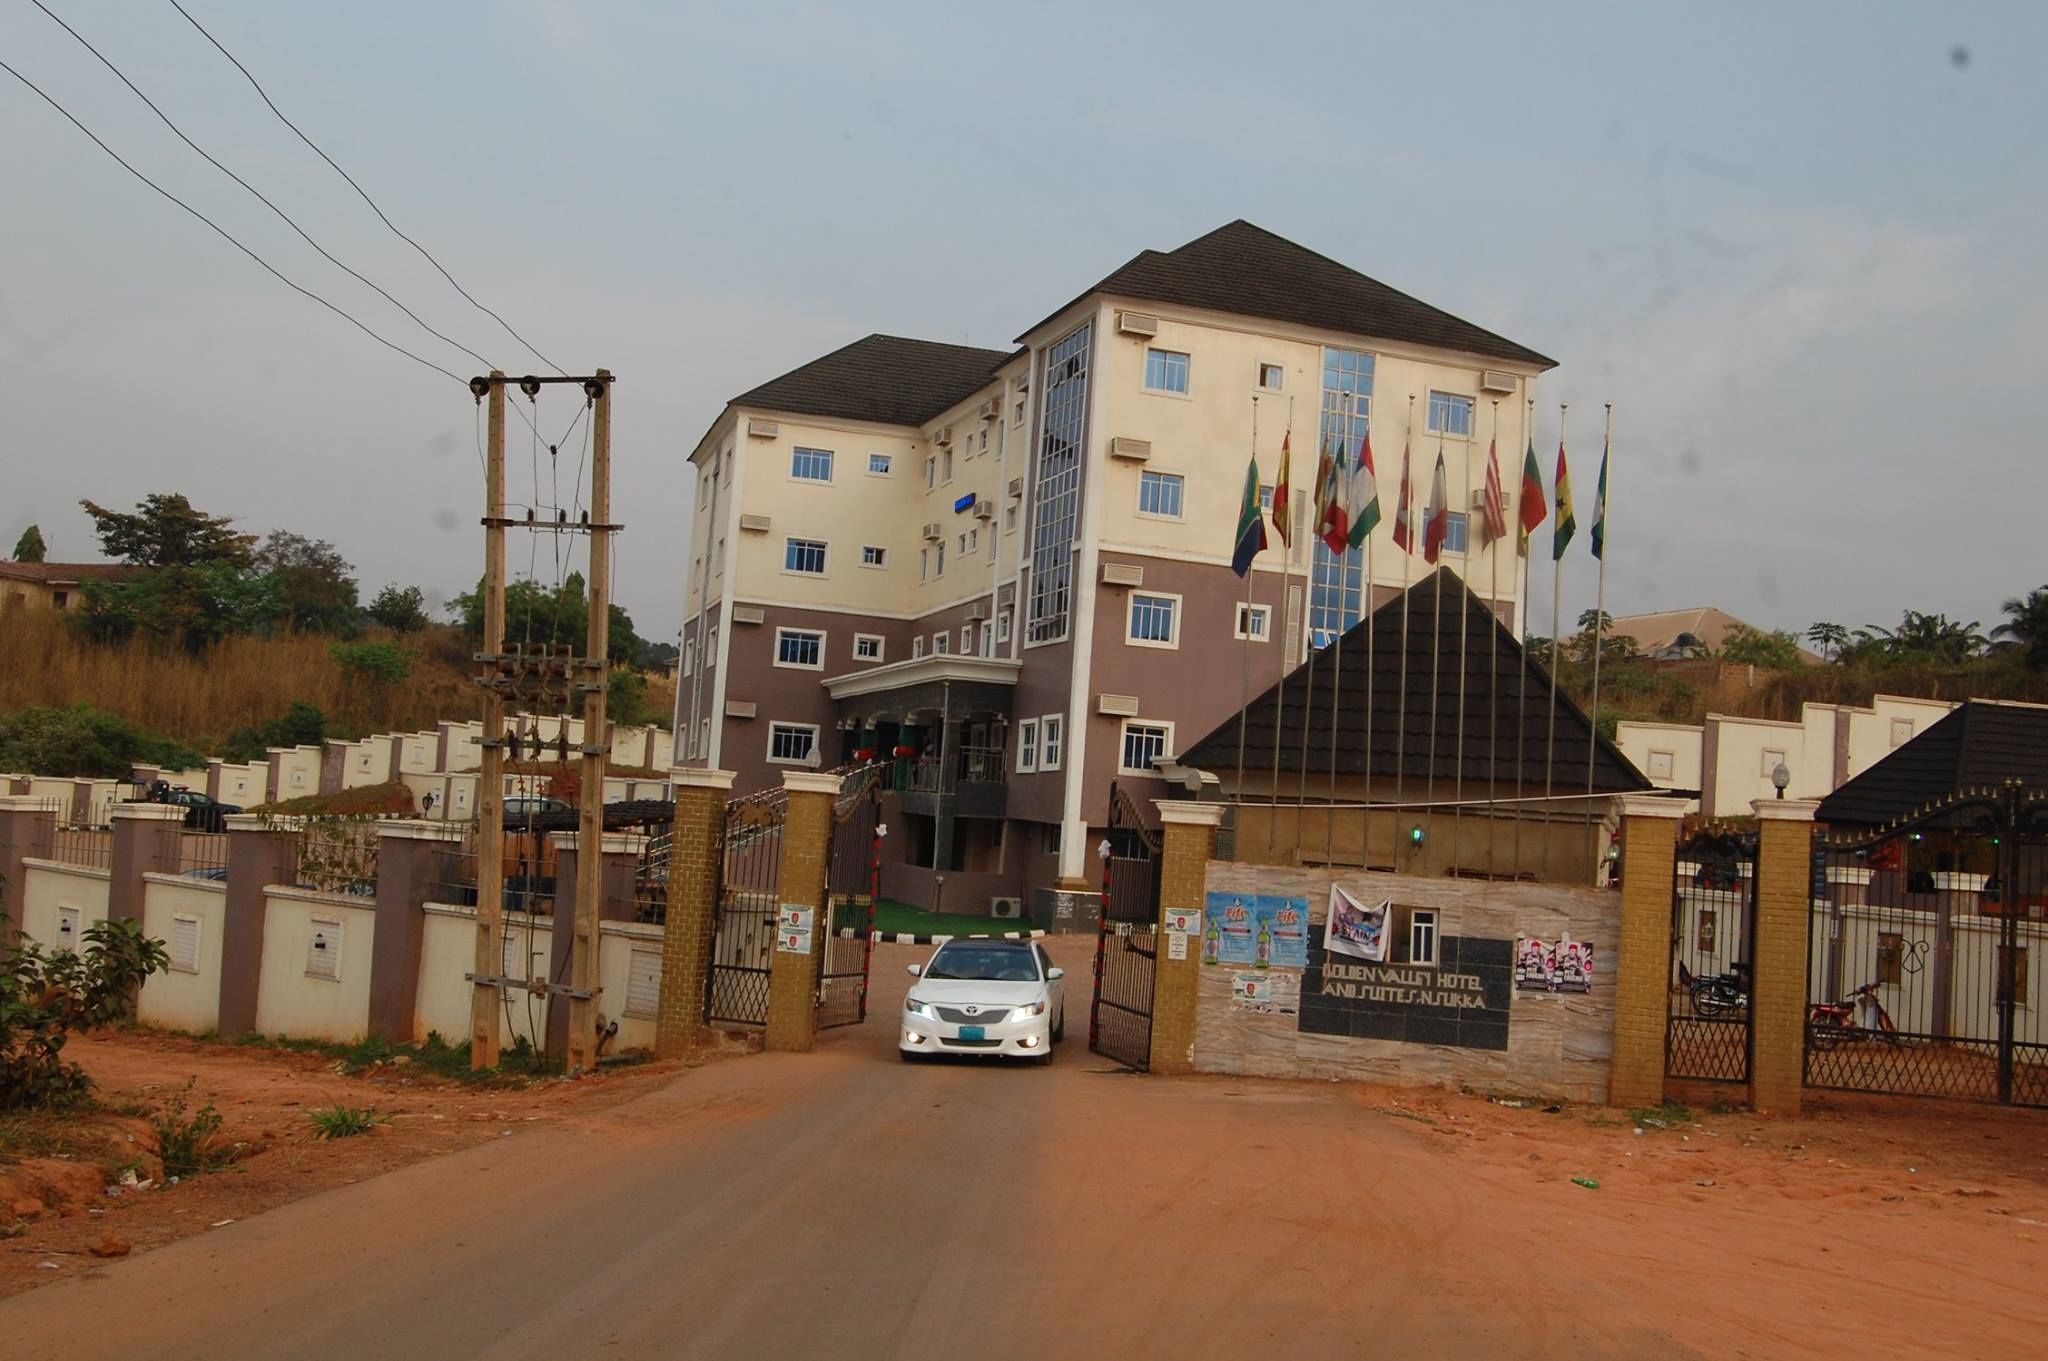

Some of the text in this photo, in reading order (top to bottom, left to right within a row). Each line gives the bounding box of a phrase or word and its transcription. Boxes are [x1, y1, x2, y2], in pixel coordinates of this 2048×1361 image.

[1322, 963, 1484, 991] GOLDEN VALLEY HOTEL
[1321, 981, 1356, 997] AND
[1421, 990, 1486, 1009] NSUKKA
